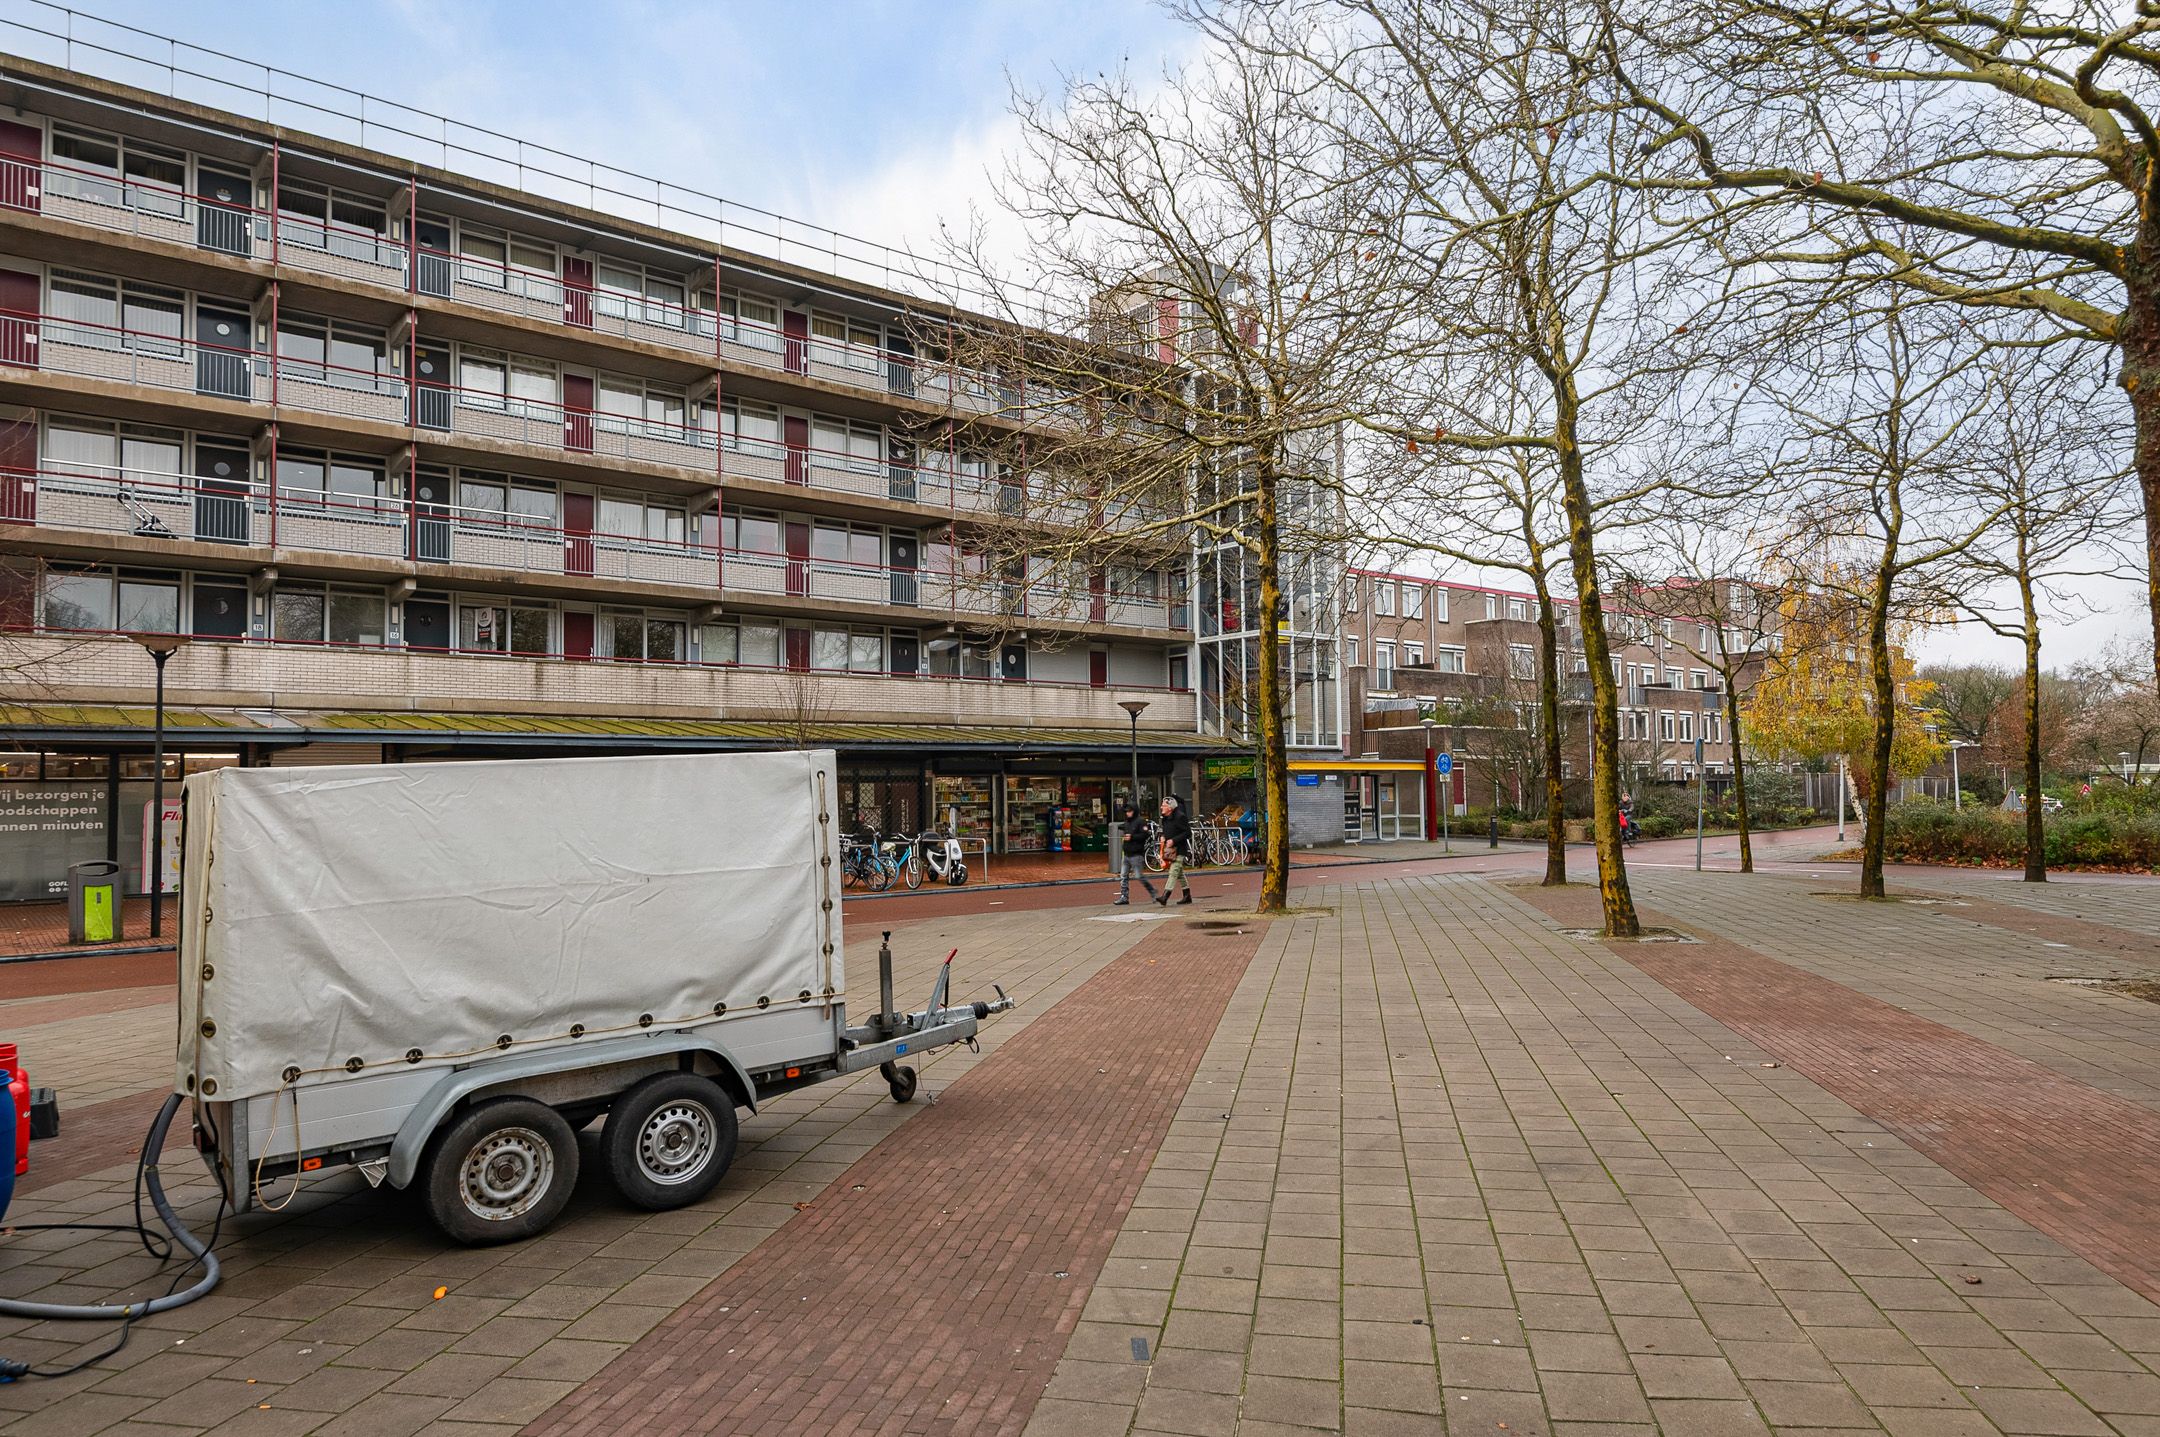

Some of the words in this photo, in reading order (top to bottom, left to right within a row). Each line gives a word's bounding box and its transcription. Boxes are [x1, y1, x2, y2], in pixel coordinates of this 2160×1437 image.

[0, 789, 11, 803] ij
[15, 789, 88, 802] bezorgen
[92, 788, 105, 801] je
[42, 820, 104, 830] minuten
